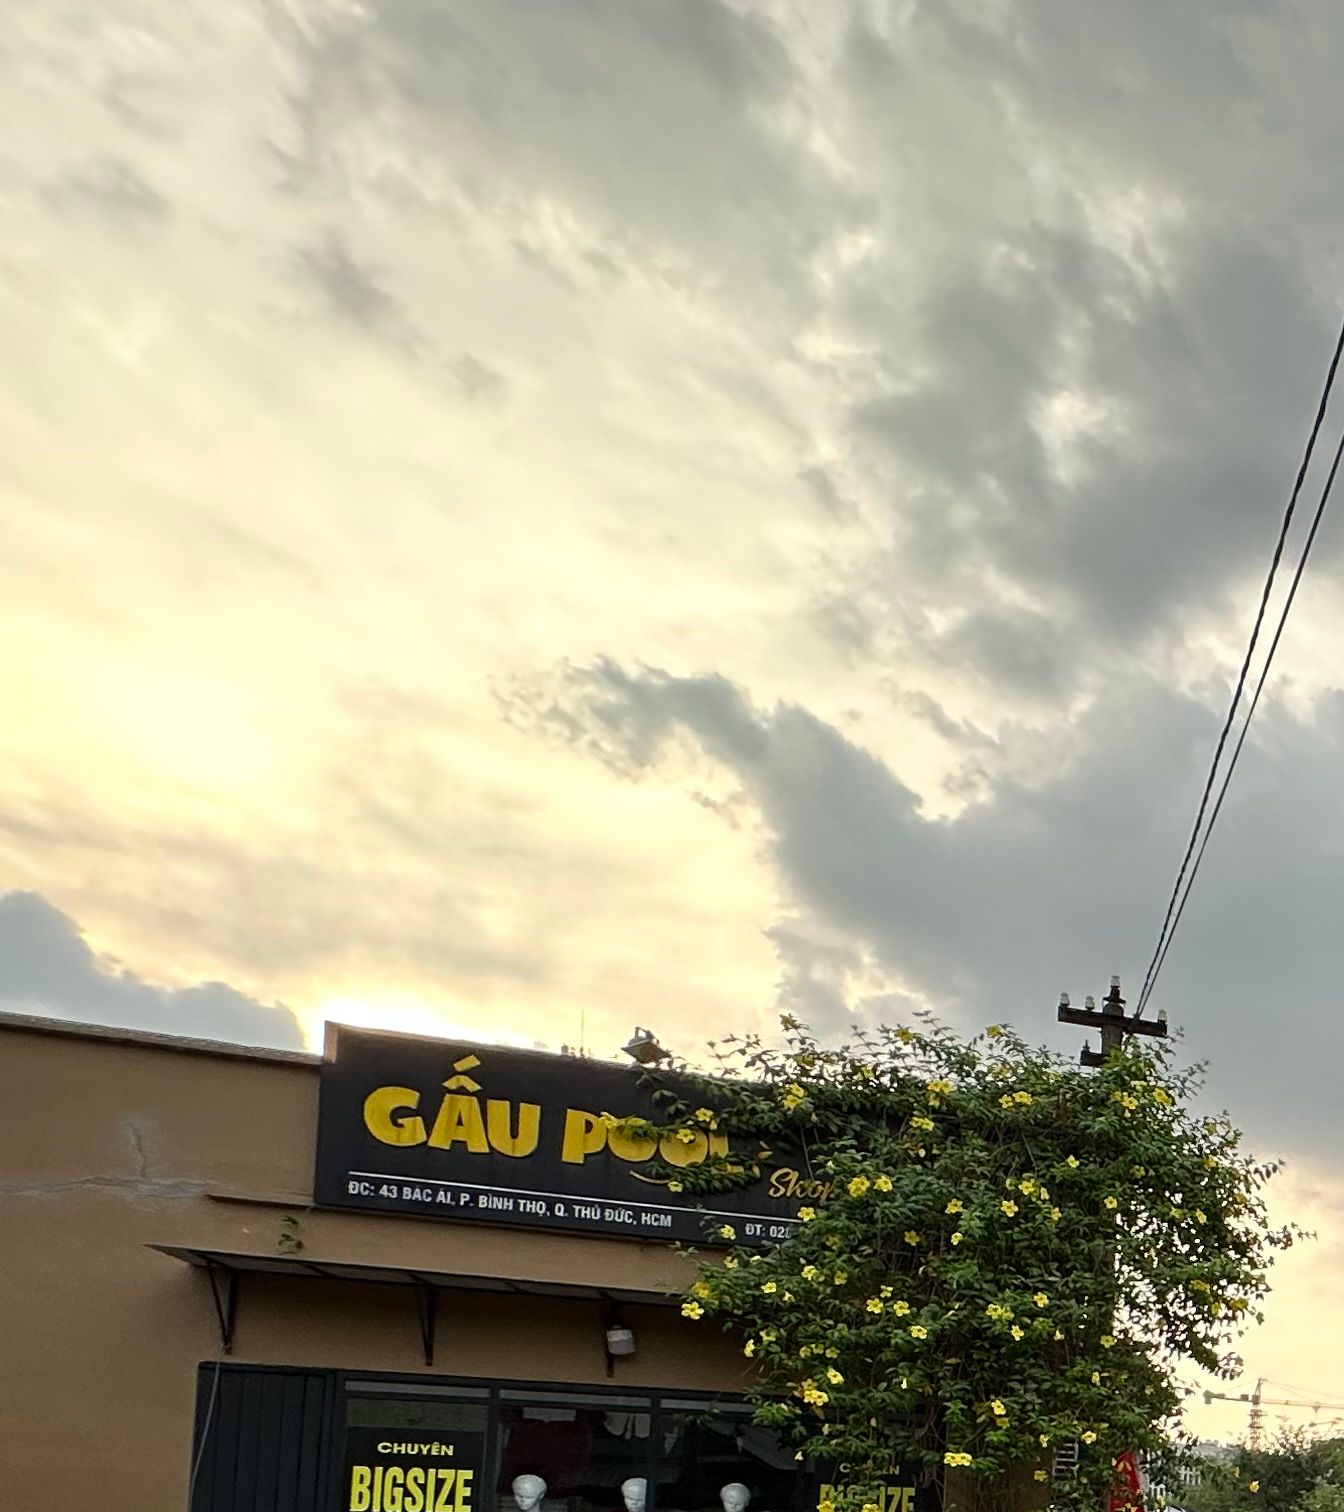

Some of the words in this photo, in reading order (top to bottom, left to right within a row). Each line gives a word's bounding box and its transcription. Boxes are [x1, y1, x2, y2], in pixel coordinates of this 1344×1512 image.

[364, 1054, 541, 1158] GẤU
[348, 1181, 375, 1196] ĐC:
[379, 1184, 397, 1199] 43
[402, 1185, 432, 1202] BÁC
[460, 1193, 474, 1207] P.
[478, 1193, 513, 1211] BÌNH
[517, 1199, 550, 1217] THỌ,
[554, 1203, 569, 1217] Q.
[572, 1204, 600, 1220] THỦ
[604, 1206, 637, 1225] ĐỨC,
[641, 1212, 672, 1227] HCM
[745, 1223, 766, 1237] ĐT:
[377, 1442, 454, 1456] CHUYÊN
